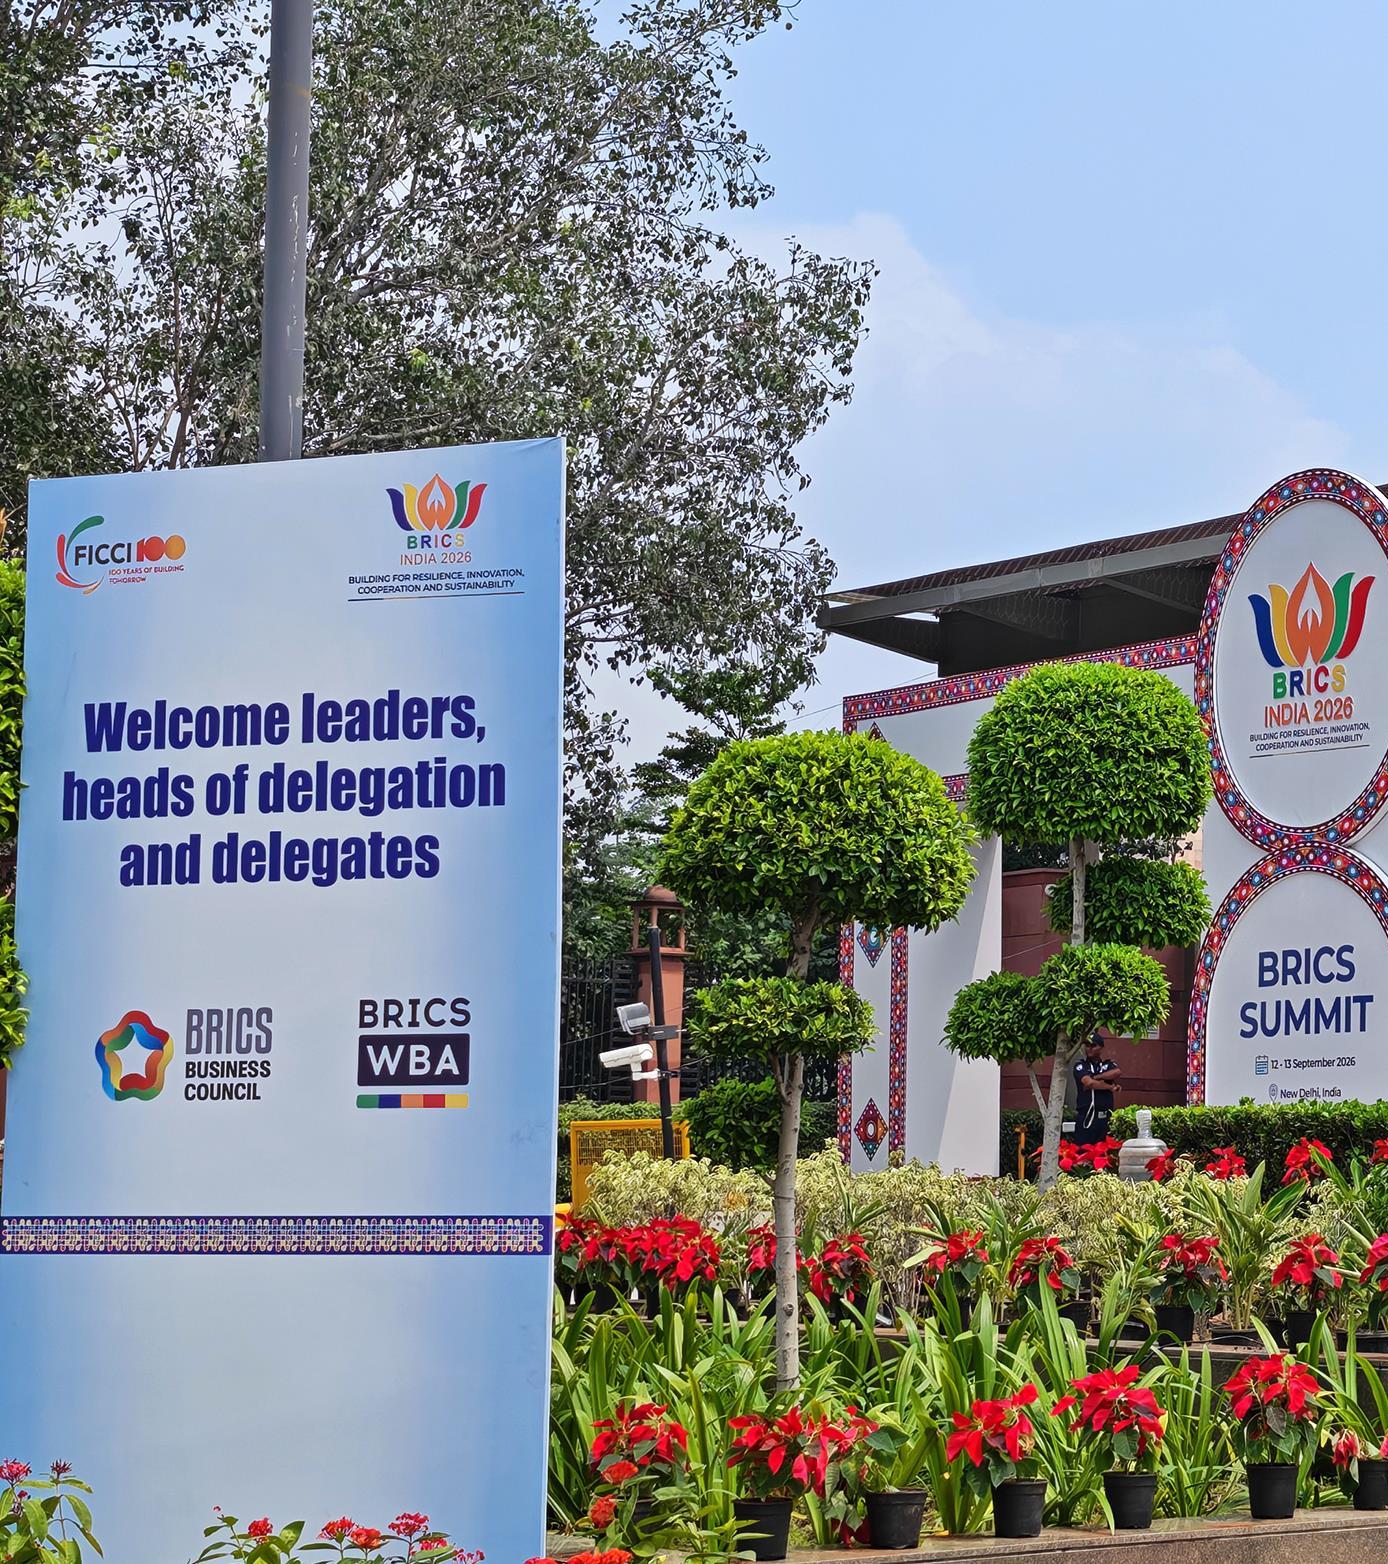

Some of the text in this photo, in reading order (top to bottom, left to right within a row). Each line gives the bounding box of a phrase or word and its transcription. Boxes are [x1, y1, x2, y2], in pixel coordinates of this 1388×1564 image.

[407, 533, 465, 550] BRICS
[74, 542, 132, 566] FICCI
[400, 551, 472, 566] INDIA 2026
[123, 567, 143, 575] YEARS
[154, 565, 185, 573] BUILDING
[349, 568, 525, 584] BUILDING FOR RESILIENCE, INNOVATION,
[357, 580, 515, 595] COOPERATION AND SUSTAINABILITY
[1273, 664, 1347, 699] BRICS
[84, 689, 486, 753] Welcome leaders,
[1264, 696, 1354, 728] INDIA 2026
[1249, 722, 1370, 742] BUILDING FOR RESILIENCE, INNOVATION,
[1255, 733, 1364, 752] COOPERATION AND SUSTAINABILITY
[62, 757, 506, 821] heads of delegation
[120, 831, 440, 887] and delegates
[1258, 944, 1356, 988] BRICS
[358, 997, 472, 1028] BRICS
[1239, 995, 1374, 1039] SUMMIT
[185, 1006, 273, 1055] BRICS
[185, 1060, 271, 1078] BUSINESS
[366, 1044, 460, 1076] WBA
[1271, 1059, 1279, 1069] 12
[1284, 1059, 1292, 1069] 13
[1292, 1057, 1335, 1070] September
[1336, 1056, 1356, 1067] 2026
[184, 1083, 261, 1101] COUNCIL
[1280, 1086, 1342, 1099] New Delhi, India
